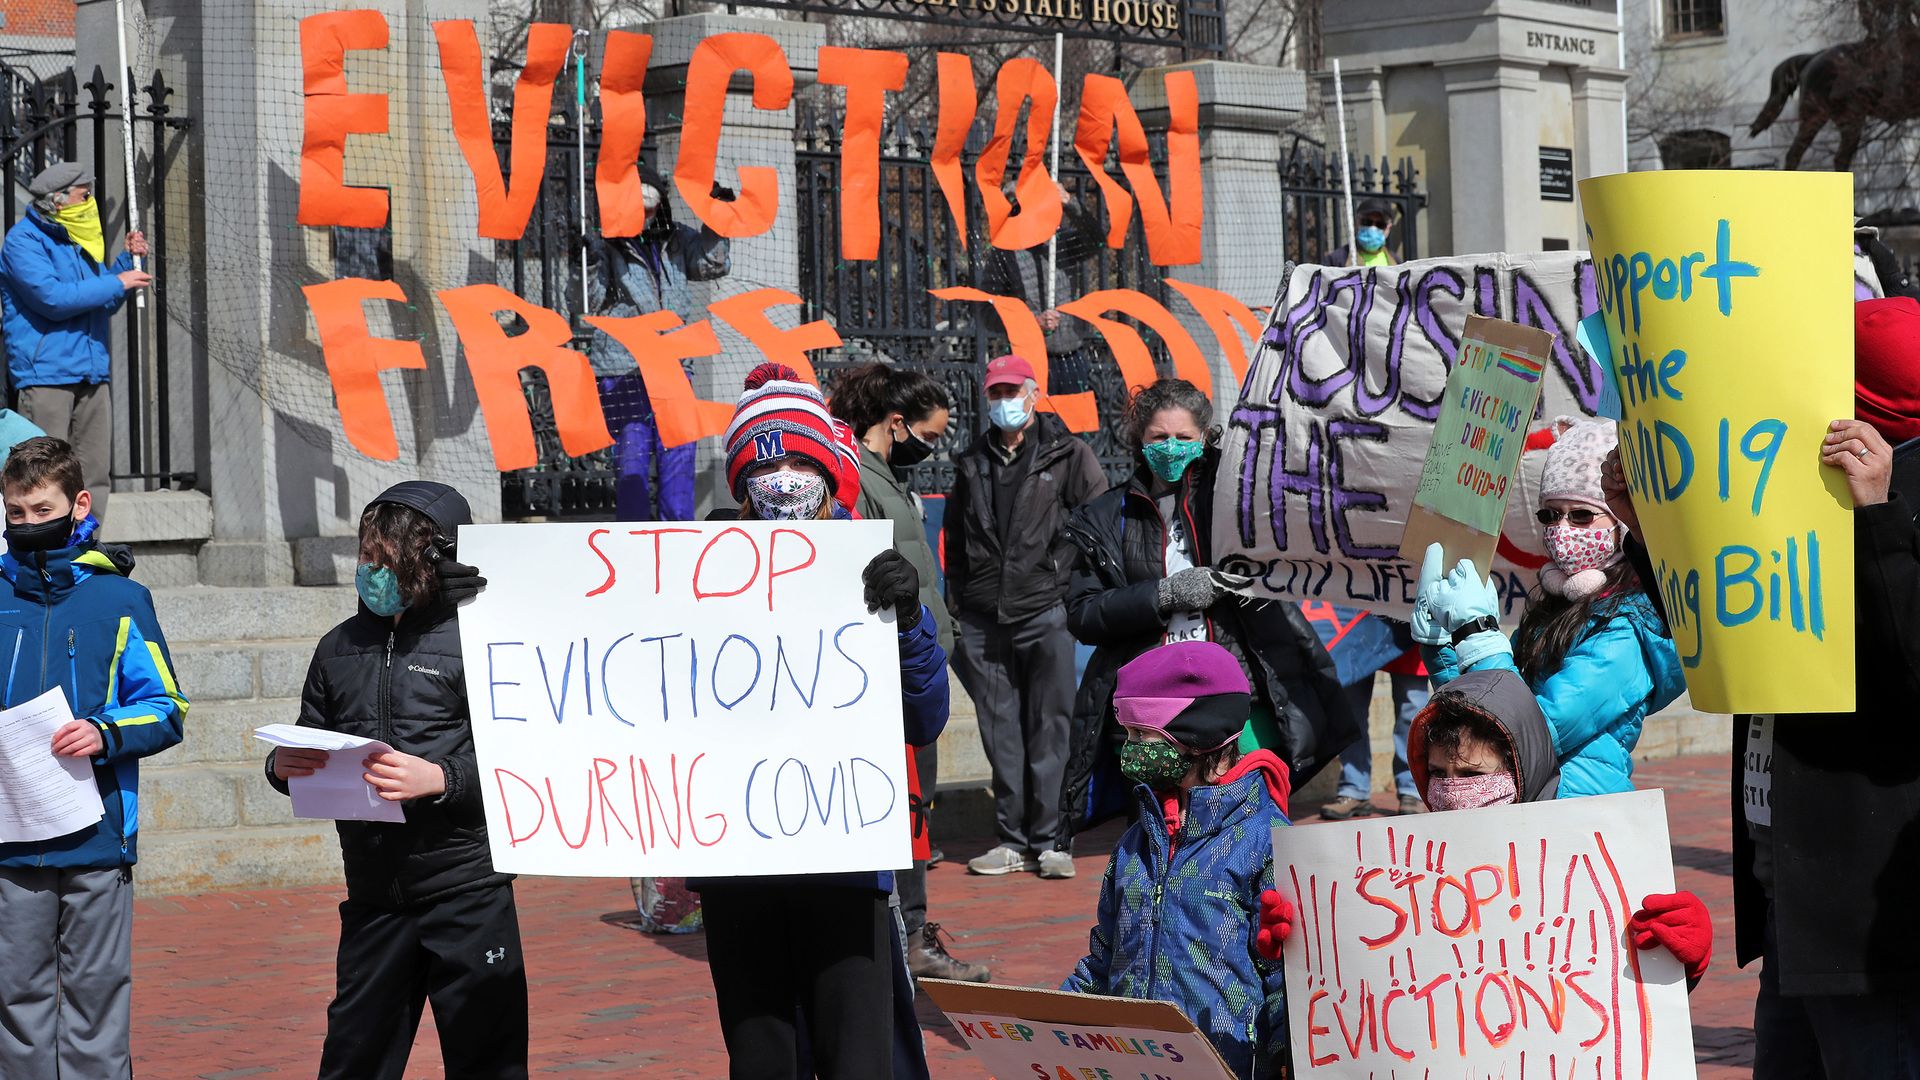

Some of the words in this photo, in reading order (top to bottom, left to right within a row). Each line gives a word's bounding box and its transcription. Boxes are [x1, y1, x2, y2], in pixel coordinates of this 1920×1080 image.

[1092, 0, 1180, 30] HOUSE
[1526, 31, 1596, 55] ENTRANCE
[297, 9, 1202, 266] EVICTION
[1586, 218, 1761, 337] upport
[1460, 344, 1494, 374] STOP
[1620, 342, 1688, 408] the
[754, 430, 786, 461] M
[1228, 402, 1404, 560] THE
[1621, 417, 1695, 505] OVID
[1717, 417, 1789, 517] 19
[585, 526, 817, 611] STOP
[1338, 561, 1419, 605] LIFE
[1715, 529, 1826, 643] Bill
[414, 665, 440, 676] Columbia
[487, 622, 869, 728] EVICTIONS
[494, 753, 727, 855] DURING
[746, 757, 896, 840] COVID
[957, 1019, 1035, 1043] KEEP
[1052, 1029, 1184, 1064] FAMILIES
[1308, 969, 1611, 1069] EVICTIONS
